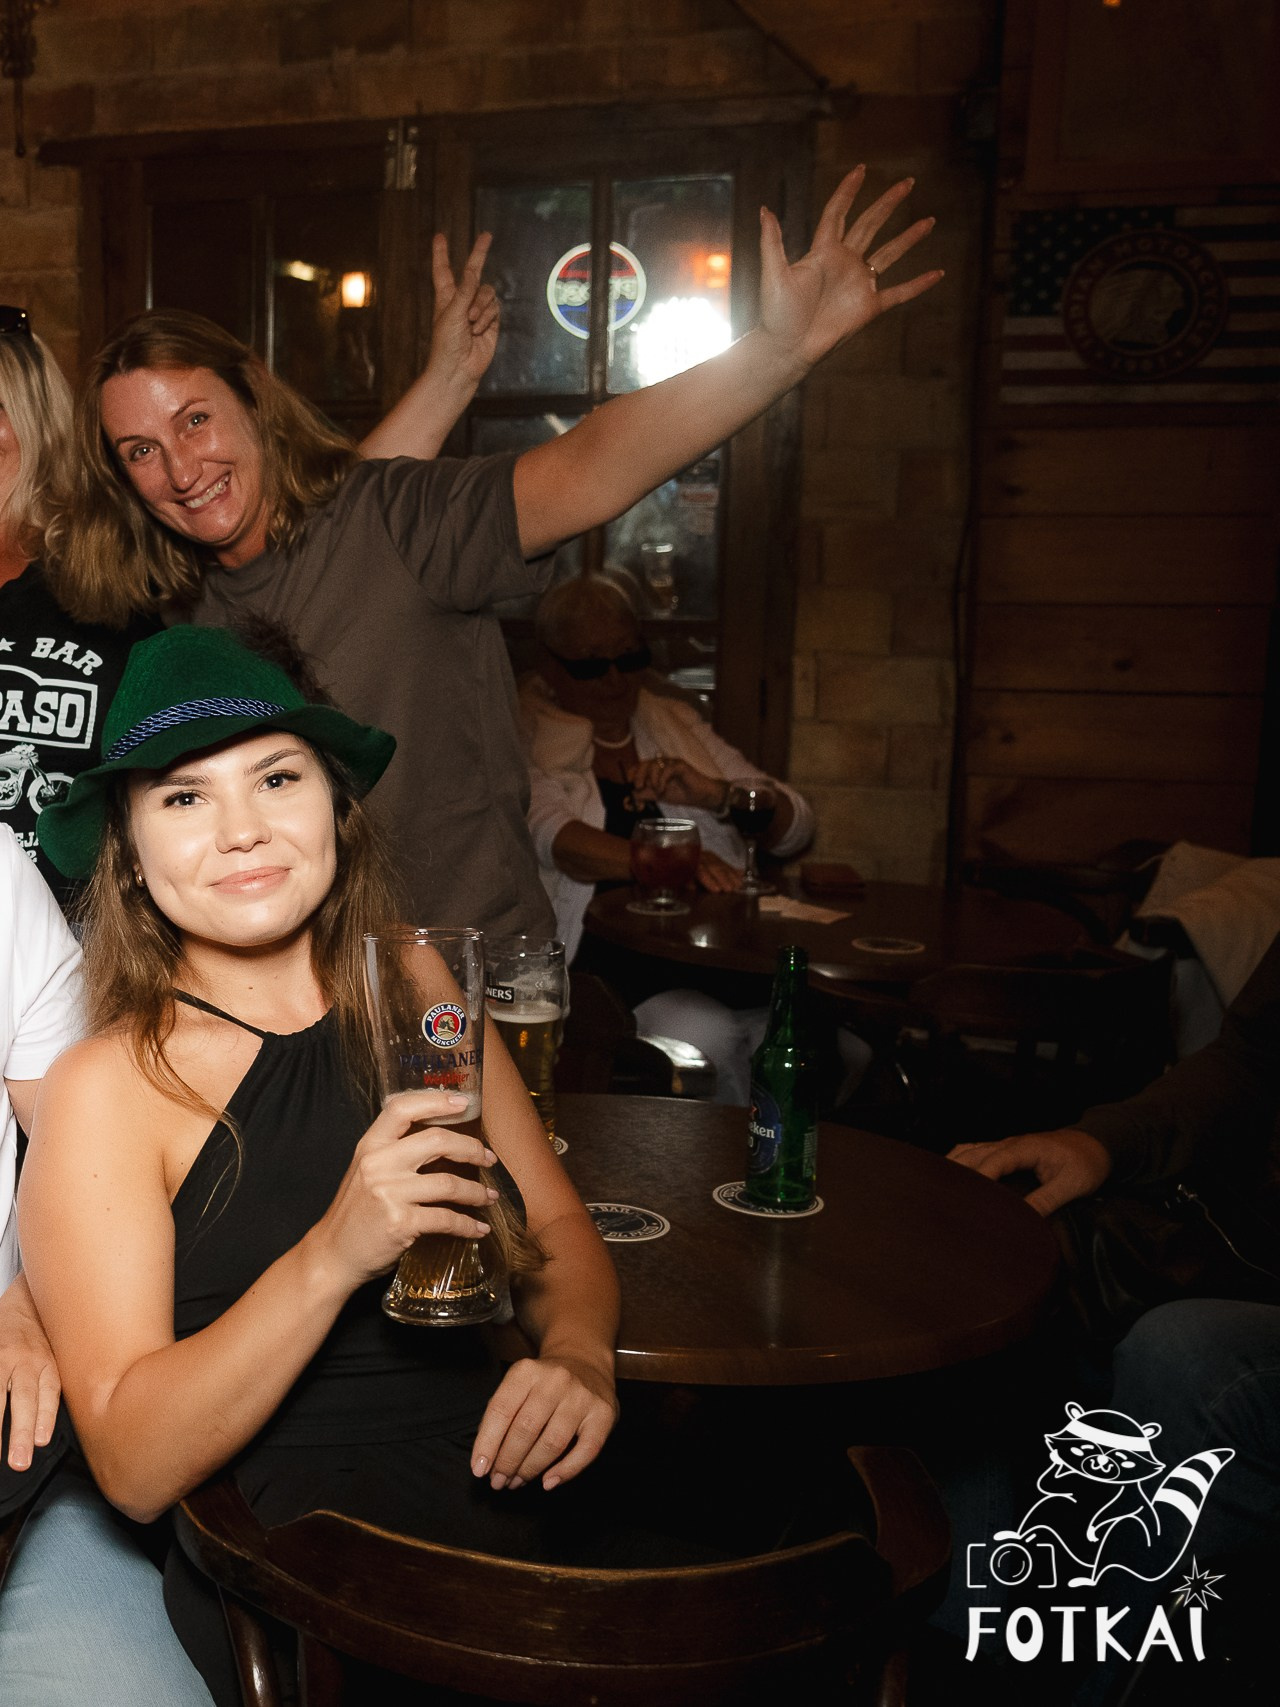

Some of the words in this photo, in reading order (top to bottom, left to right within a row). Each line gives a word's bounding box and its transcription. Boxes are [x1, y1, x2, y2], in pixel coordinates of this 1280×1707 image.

[31, 637, 104, 676] BAR
[485, 986, 513, 1001] NERS
[426, 1004, 465, 1022] PAULANER
[748, 1121, 775, 1139] eken
